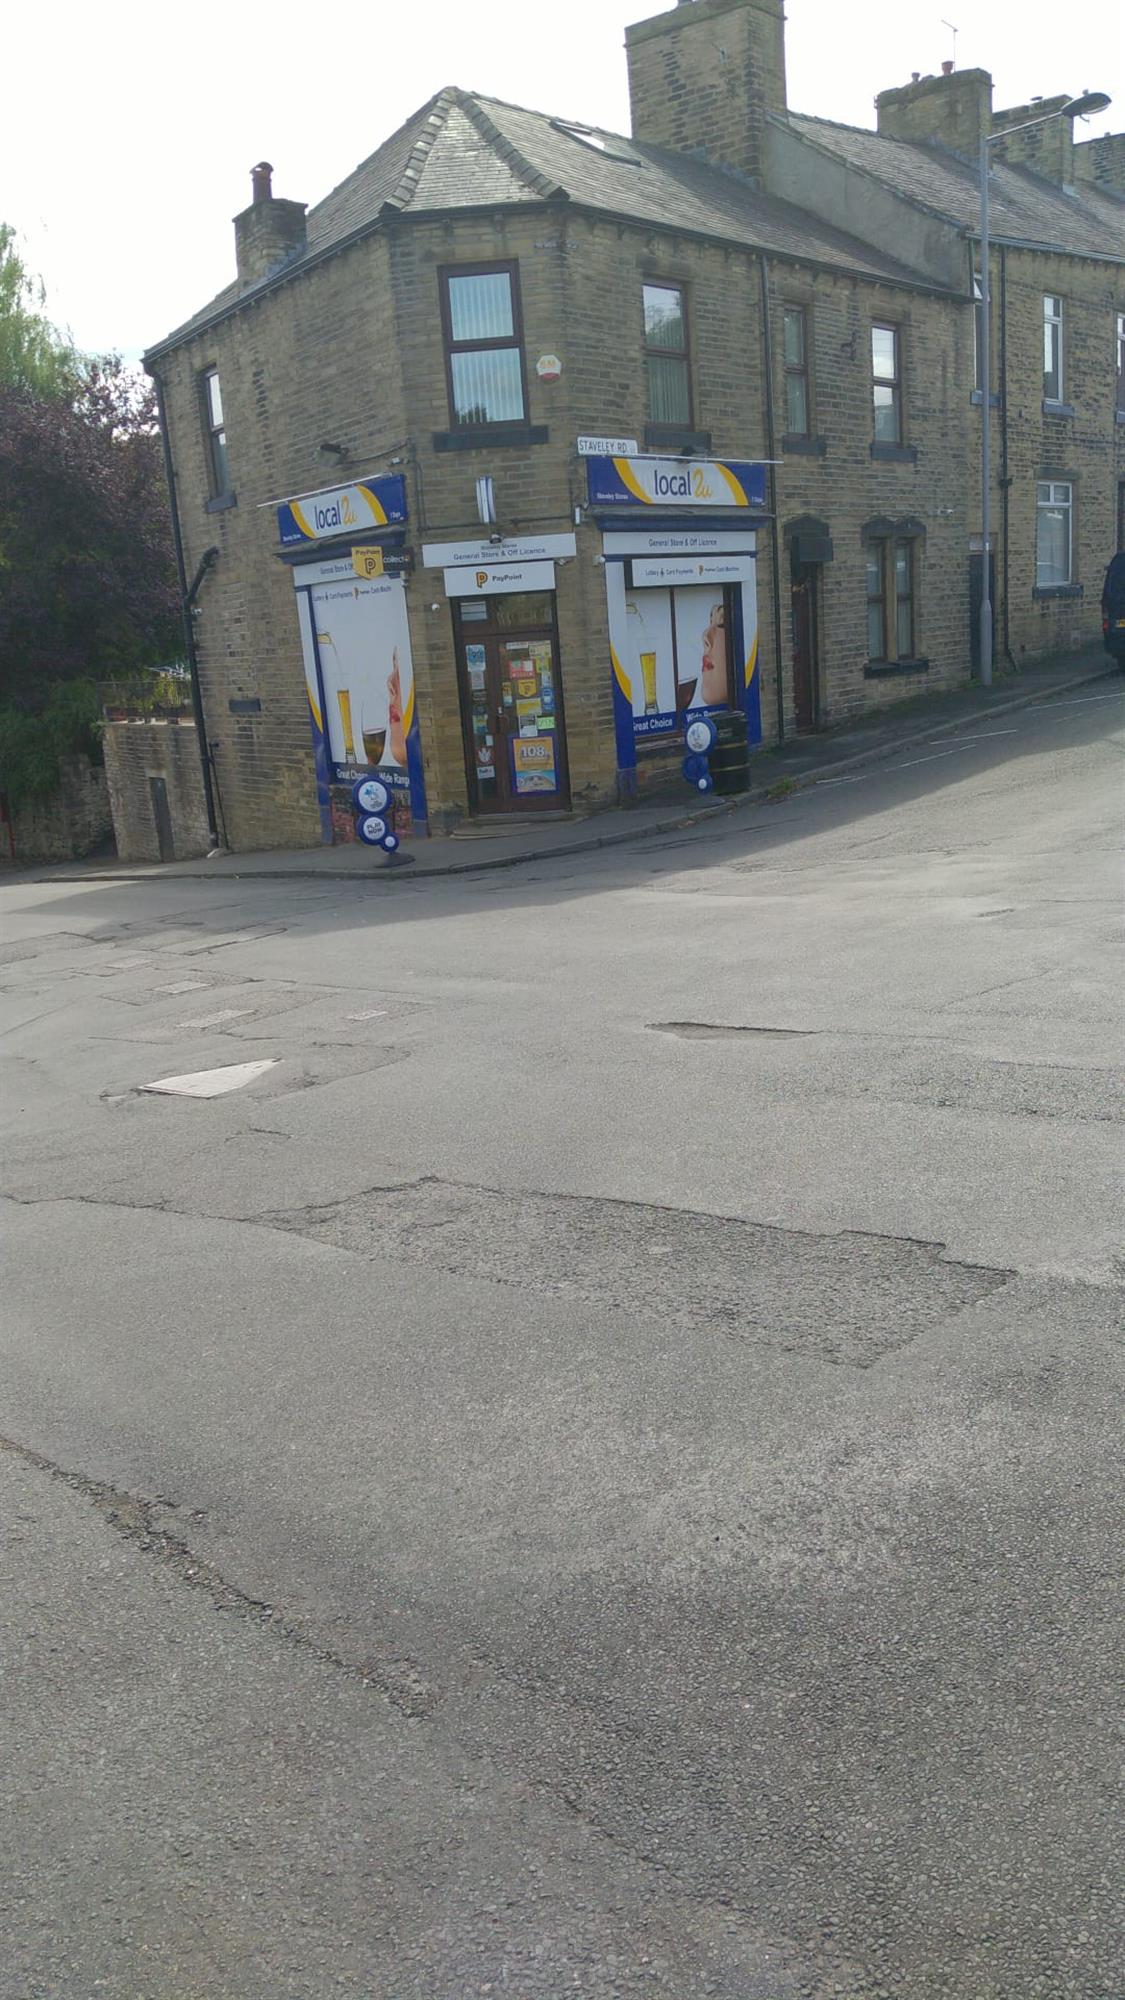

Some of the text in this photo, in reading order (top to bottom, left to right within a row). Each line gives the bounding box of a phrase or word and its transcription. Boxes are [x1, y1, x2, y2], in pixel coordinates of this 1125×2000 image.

[579, 440, 628, 453] STAVELEY RD
[453, 552, 480, 561] General
[507, 548, 519, 556] Off
[519, 547, 546, 556] Licence
[492, 573, 522, 582] PayPoint
[649, 717, 673, 729] Choice
